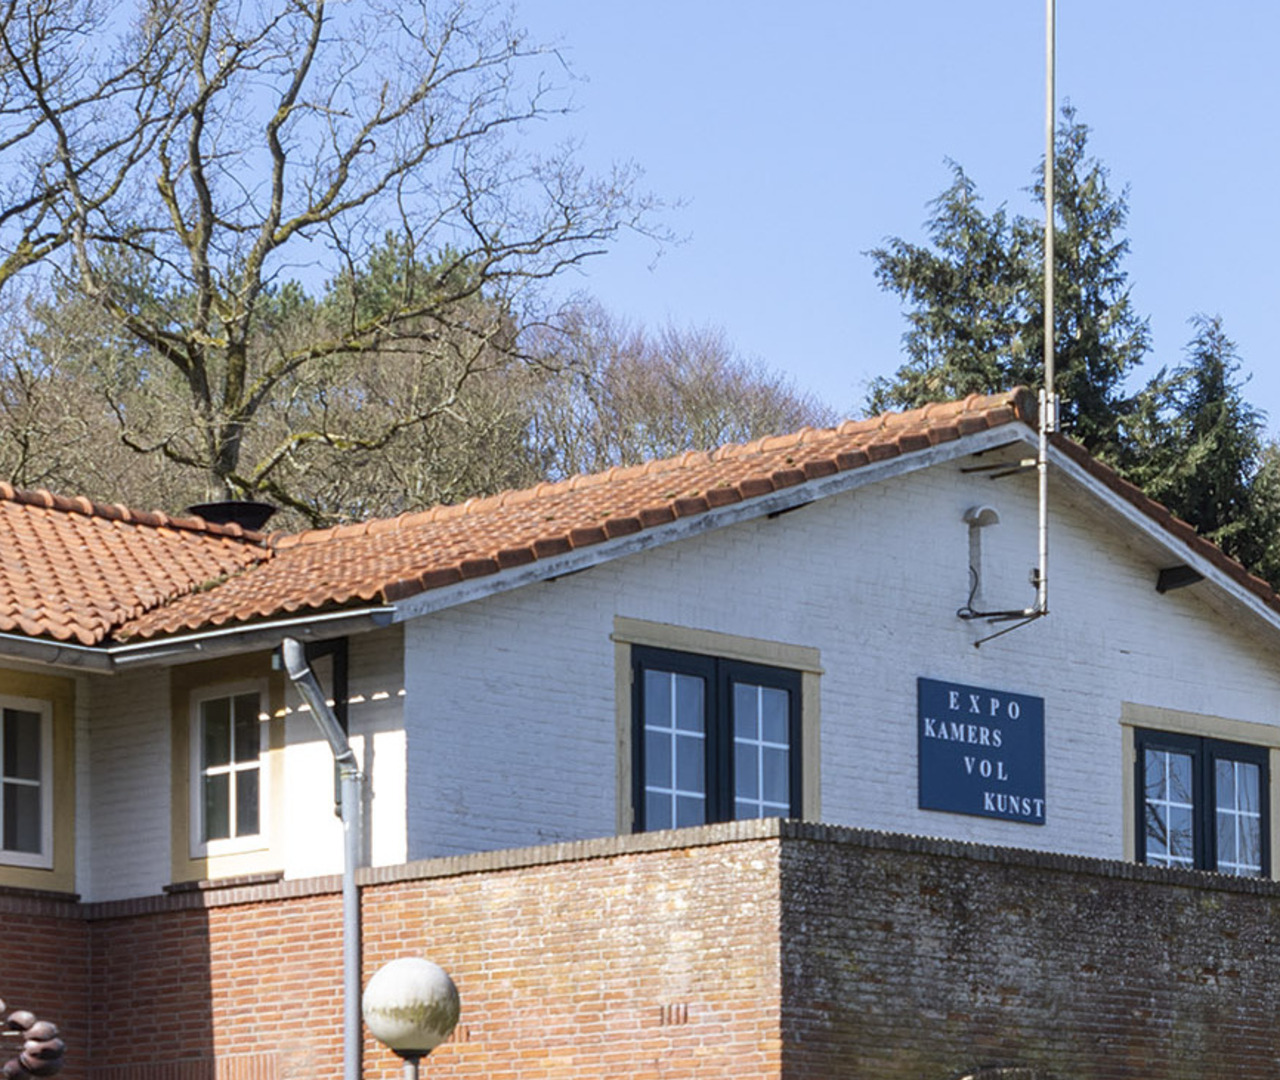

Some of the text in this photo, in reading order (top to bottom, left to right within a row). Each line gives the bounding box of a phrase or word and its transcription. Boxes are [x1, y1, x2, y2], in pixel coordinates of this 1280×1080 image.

[949, 691, 1020, 720] EXPO
[924, 718, 1003, 748] KAMERS
[964, 756, 1008, 781] VOL
[984, 792, 1044, 818] KUNST
